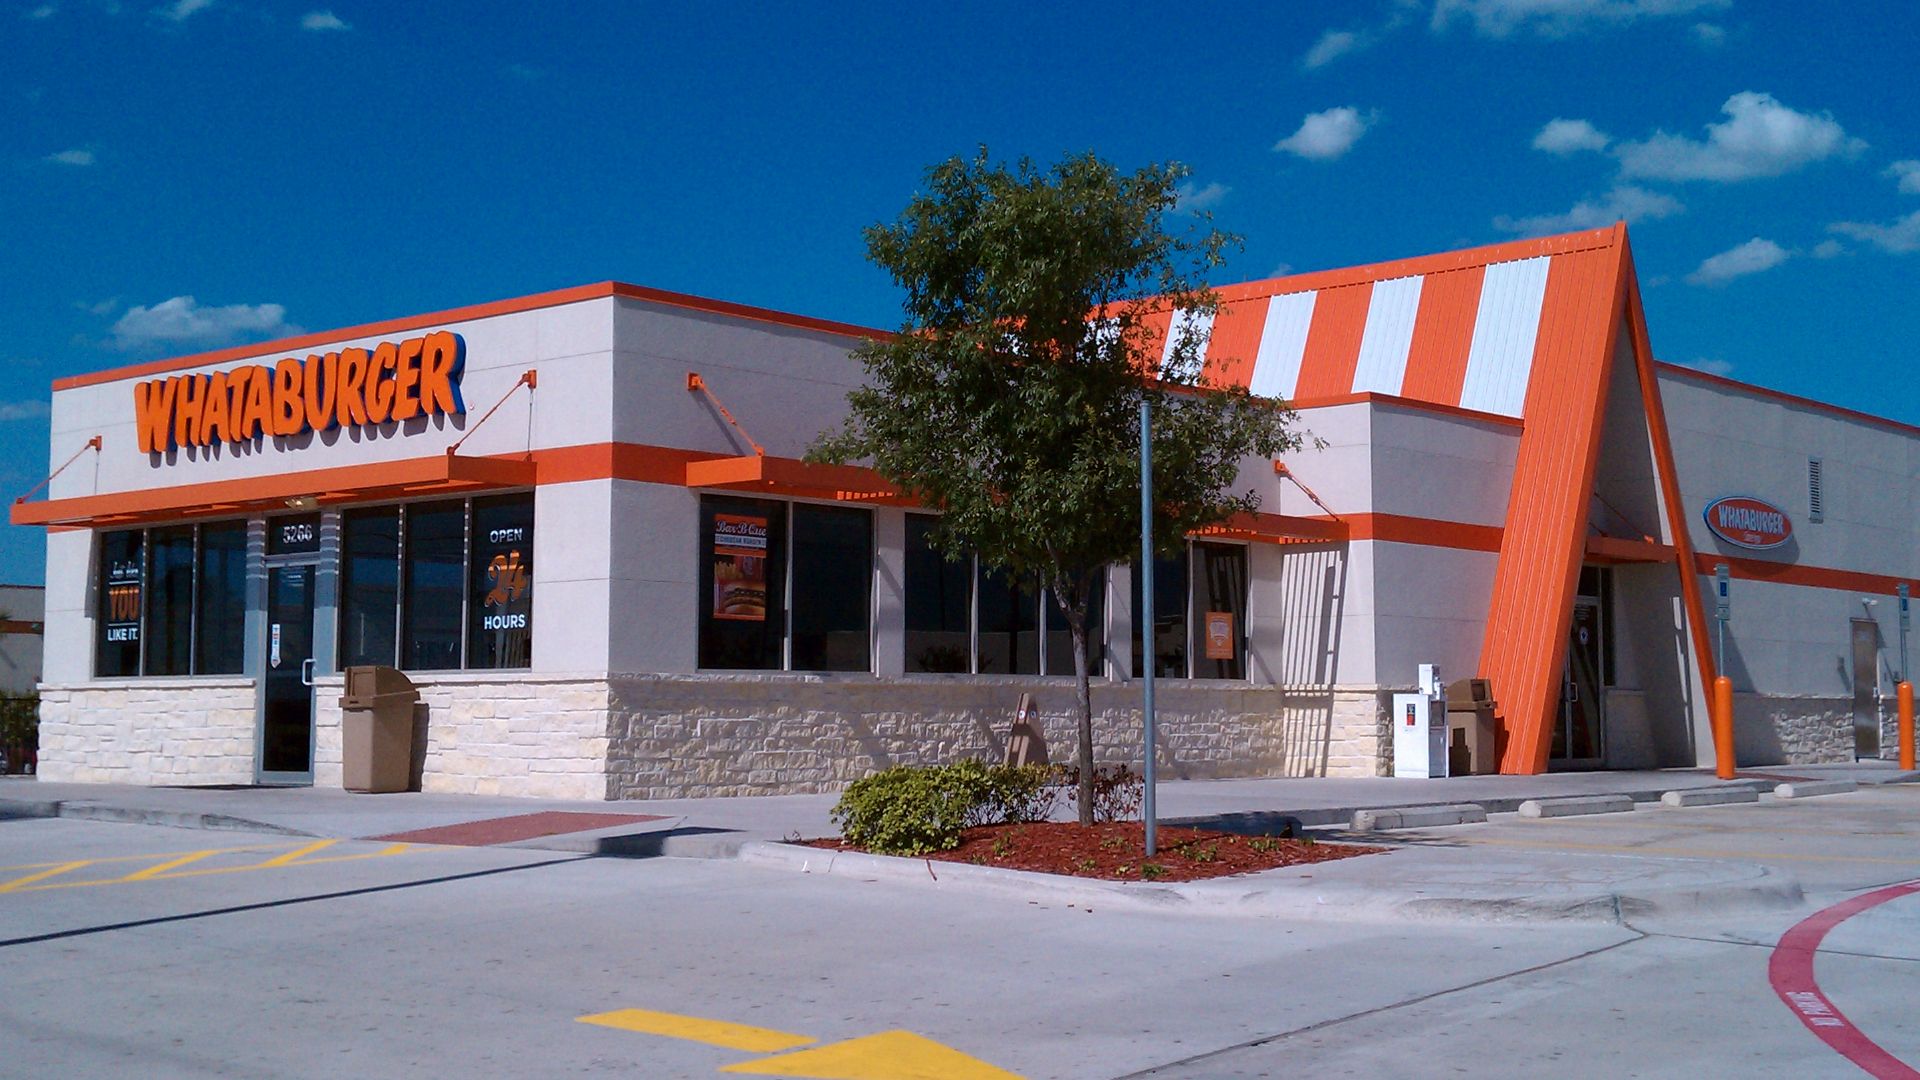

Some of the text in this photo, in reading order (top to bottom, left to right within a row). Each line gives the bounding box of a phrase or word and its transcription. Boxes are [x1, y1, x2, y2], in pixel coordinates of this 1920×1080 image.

[134, 330, 465, 454] WHATABURGER
[1718, 504, 1784, 535] WHATABURGER
[282, 524, 313, 544] 5266
[489, 527, 523, 543] OPEN
[484, 549, 527, 608] 24
[108, 586, 140, 620] YOU
[483, 613, 526, 630] HOURS
[107, 628, 128, 642] LIKE
